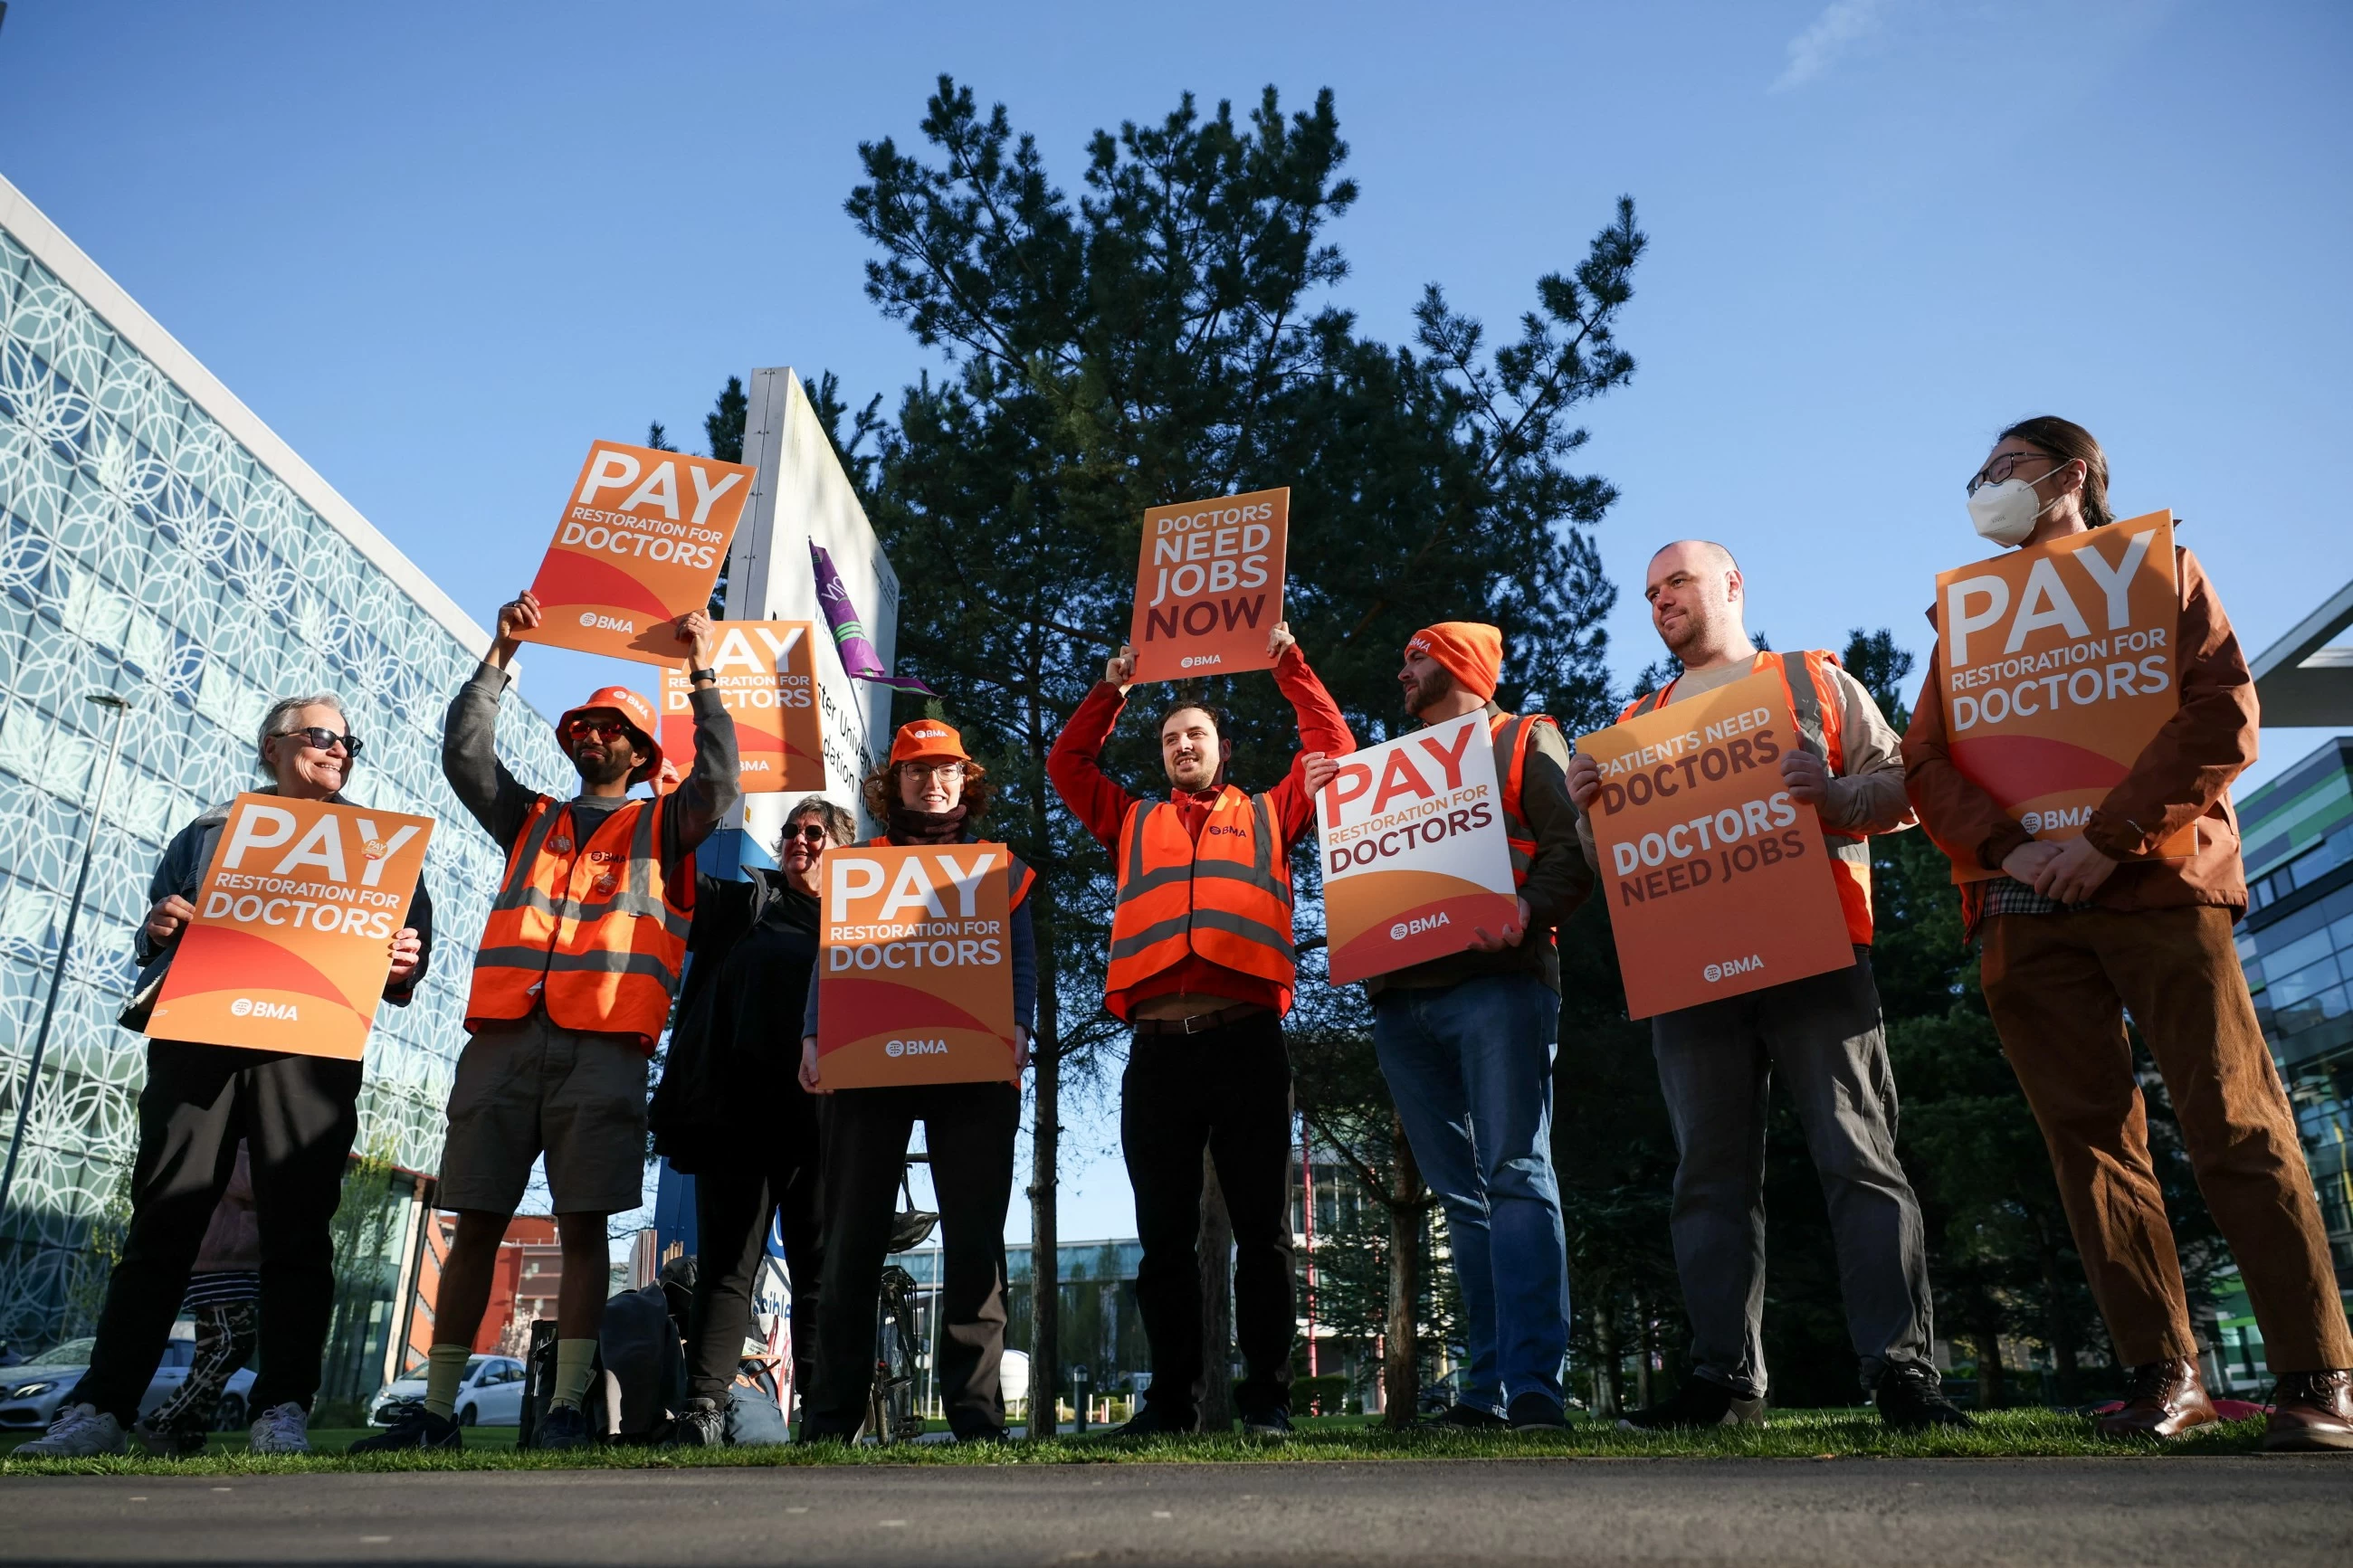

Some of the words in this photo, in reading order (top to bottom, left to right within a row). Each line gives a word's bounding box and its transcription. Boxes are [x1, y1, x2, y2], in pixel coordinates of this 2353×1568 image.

[578, 450, 745, 525] PAY
[572, 507, 686, 537] RESTORATION
[689, 527, 722, 543] FOR
[1157, 503, 1272, 535] DOCTORS
[560, 522, 716, 568] DOCTORS
[1154, 524, 1271, 565] NEED
[1149, 555, 1268, 607] JOBS
[1948, 528, 2157, 668] PAY
[596, 616, 633, 633] BMA
[1145, 594, 1265, 641] NOW
[668, 628, 805, 675] AY
[1194, 654, 1221, 666] BMA
[1951, 639, 2107, 691] RESTORATION
[2114, 628, 2166, 655] FOR
[668, 676, 776, 688] RERATION
[780, 675, 809, 686] FOR
[668, 689, 812, 709] DCTORS
[1953, 655, 2169, 731] DOCTORS
[626, 694, 649, 720] BMA
[926, 729, 948, 738] BMA
[1597, 731, 1700, 780] PATIENTS
[1705, 707, 1770, 743] NEED
[1324, 722, 1476, 829] PAY
[1600, 730, 1779, 816] DOCTORS
[1222, 825, 1246, 838] BMA
[1328, 796, 1448, 846] RESTORATION
[1453, 784, 1488, 806] FOR
[1613, 792, 1796, 876] DOCTORS
[2044, 805, 2093, 830] BMA
[222, 803, 421, 887] PAY
[368, 840, 387, 851] PAY
[1329, 802, 1492, 874] DOCTORS
[604, 852, 625, 864] BMA
[1620, 859, 1711, 907] NEED
[1720, 831, 1805, 883] JOBS
[214, 872, 356, 902] RESTORATION
[359, 890, 400, 909] FOR
[831, 853, 996, 922] PAY
[203, 892, 394, 939] DOCTORS
[830, 922, 959, 941] RESTORATION
[964, 920, 1000, 936] FOR
[1410, 911, 1450, 936] BMA
[830, 938, 1001, 972] DOCTORS
[1722, 954, 1765, 977] BMA
[252, 1002, 298, 1021] BMA
[907, 1039, 948, 1055] BMA
